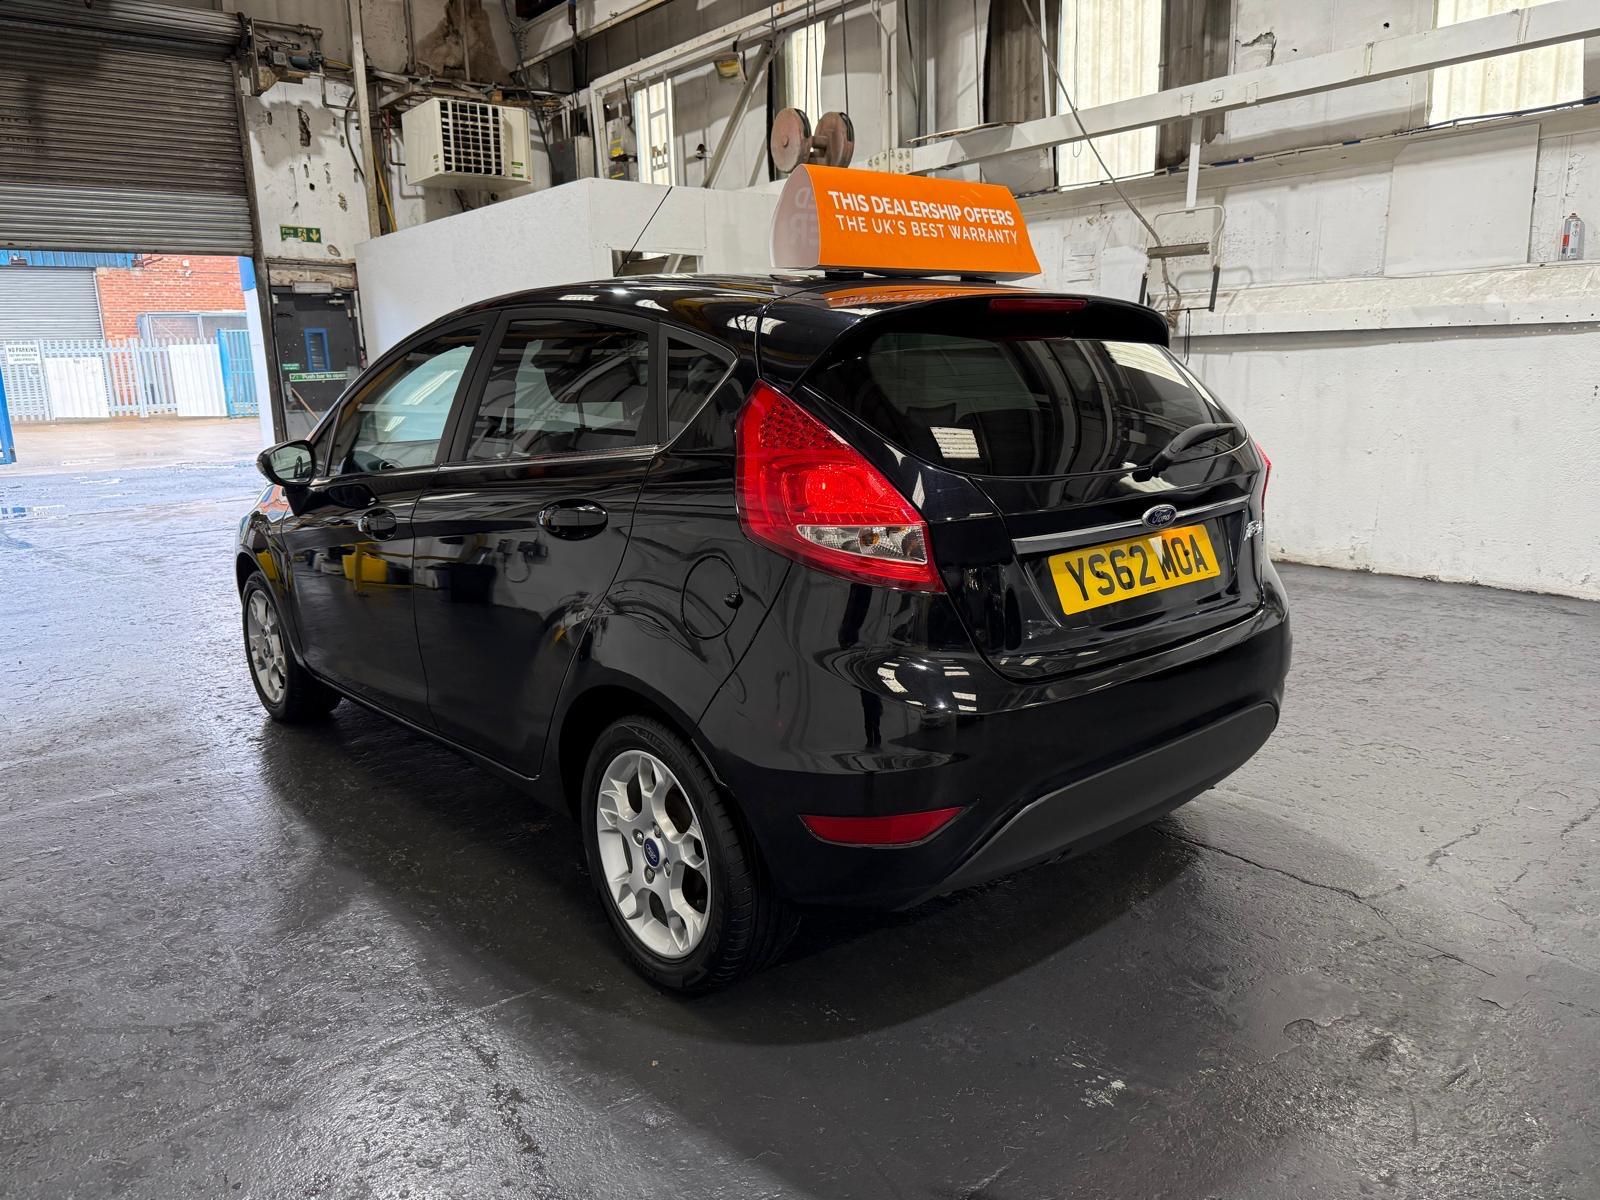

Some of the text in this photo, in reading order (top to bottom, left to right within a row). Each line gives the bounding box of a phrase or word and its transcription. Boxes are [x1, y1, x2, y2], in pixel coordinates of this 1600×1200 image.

[828, 191, 1015, 227] THIS DEALERSHIP OFFERS
[836, 214, 1018, 245] THE UK'S BEST WARRANTY
[1065, 544, 1156, 601] YS62
